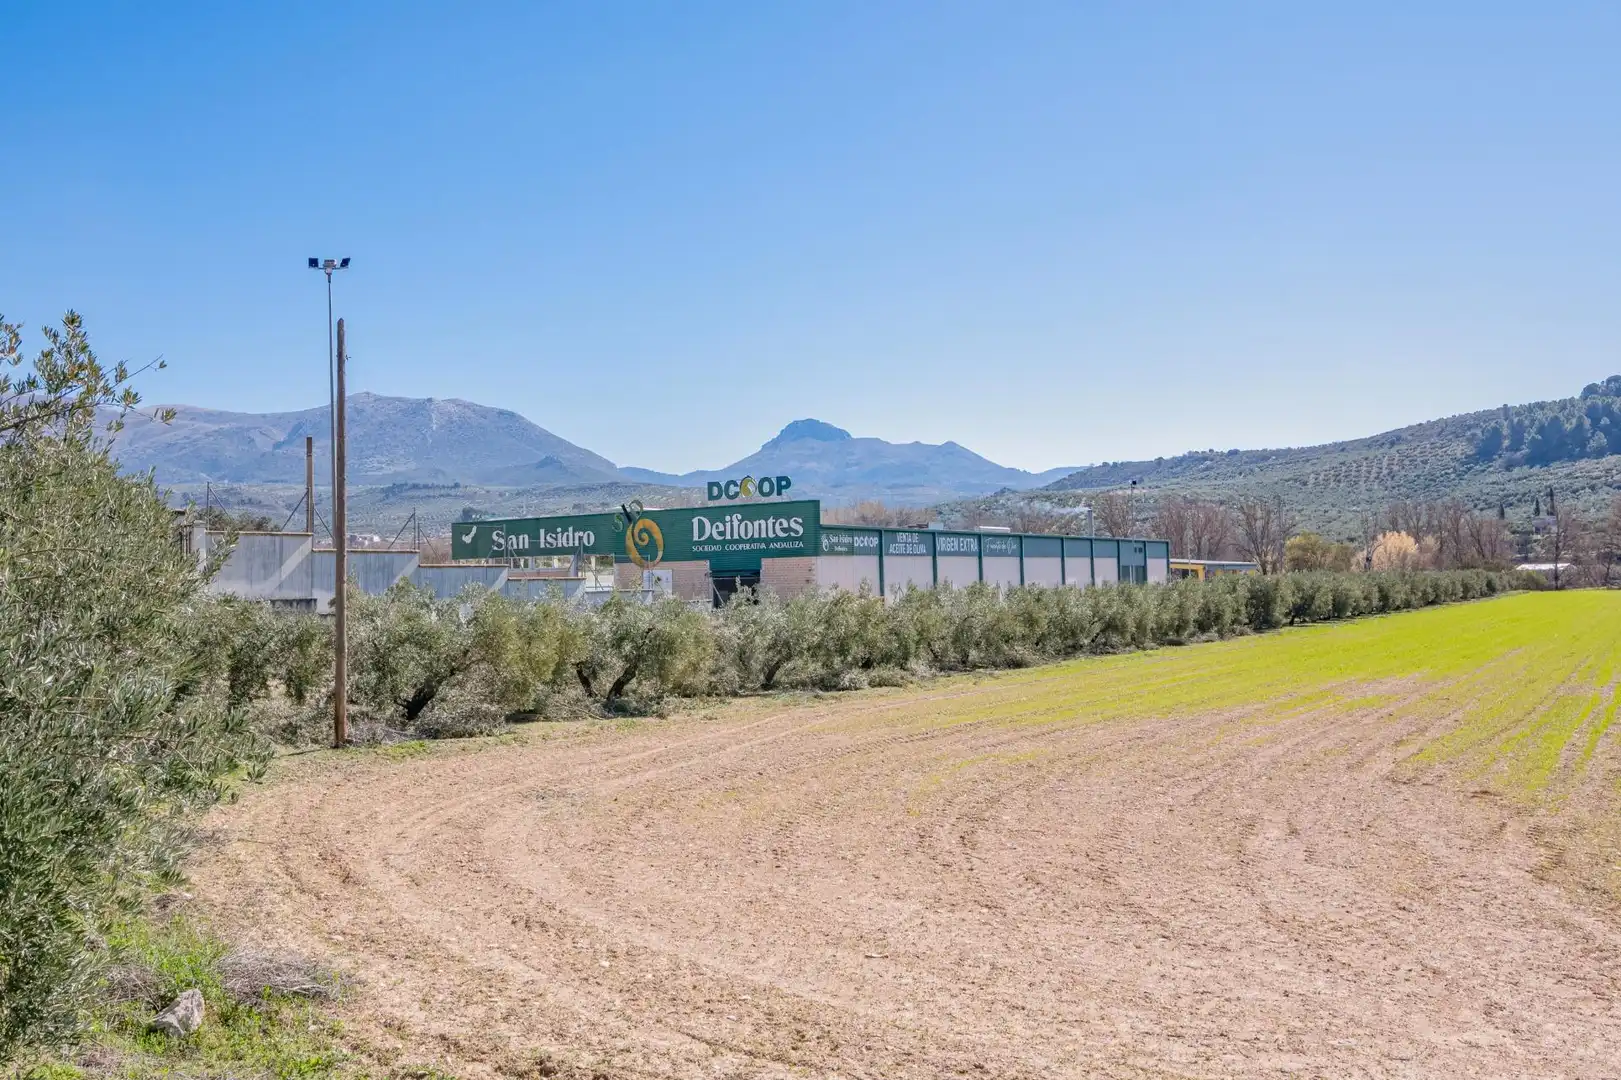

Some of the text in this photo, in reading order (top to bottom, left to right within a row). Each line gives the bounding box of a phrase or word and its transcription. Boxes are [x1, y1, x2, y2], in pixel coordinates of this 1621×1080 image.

[692, 513, 804, 541] Deifontes
[491, 527, 595, 551] San Isidro
[896, 533, 919, 542] VENTA DE
[692, 541, 804, 552] SOCIEDAD COOPERATIVA ANDALUZA
[889, 543, 926, 554] ACEITE DE OLIVA
[936, 537, 978, 552] VIRGEN EXTRA
